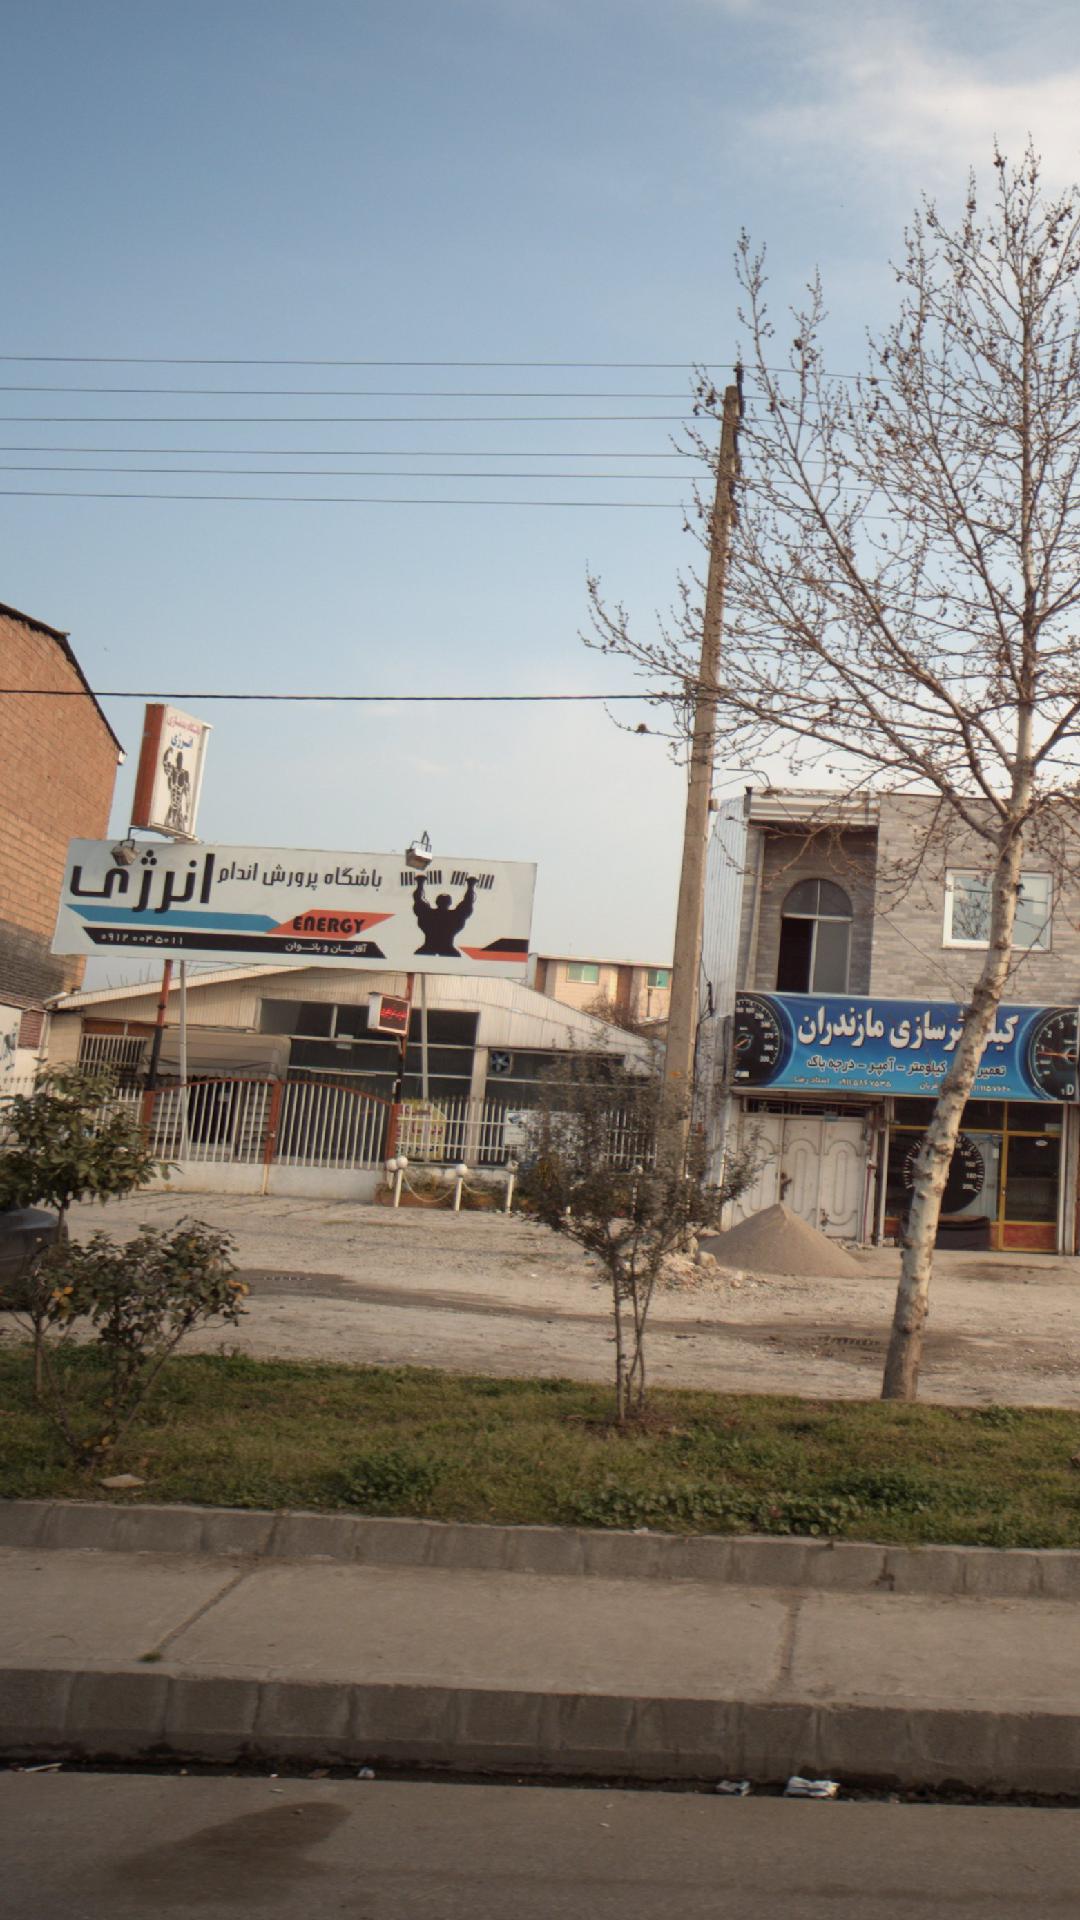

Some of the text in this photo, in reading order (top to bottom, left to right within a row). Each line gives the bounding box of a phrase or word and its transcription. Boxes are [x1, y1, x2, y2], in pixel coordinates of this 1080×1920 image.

[70, 849, 216, 914] انرژی
[217, 861, 383, 892] باشگاه پرورش اندام
[292, 915, 366, 934] ENERGY
[285, 941, 368, 955] آقایان و بانوان
[797, 1005, 884, 1047] مازندران
[828, 1058, 855, 1074] درجه
[866, 1056, 896, 1077] آمپر
[906, 1059, 948, 1078] کیلومتر
